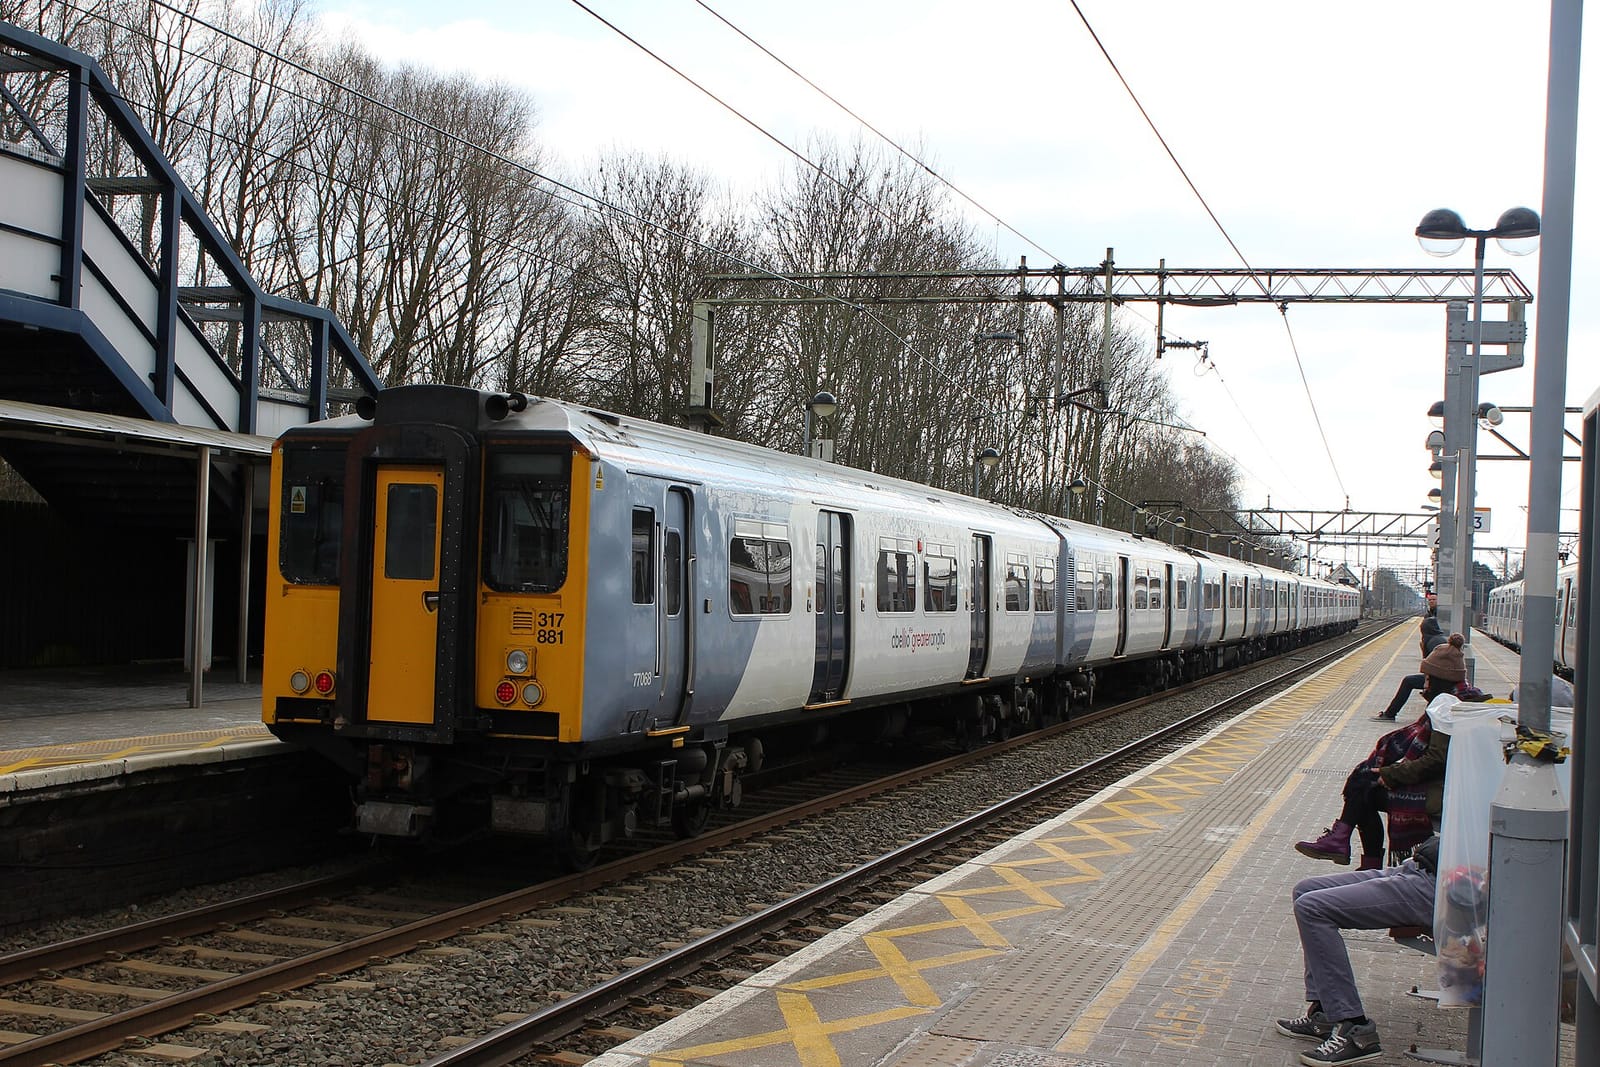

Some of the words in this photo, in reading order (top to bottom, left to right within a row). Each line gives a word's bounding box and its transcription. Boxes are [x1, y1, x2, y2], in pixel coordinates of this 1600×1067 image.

[817, 442, 823, 458] 1
[1473, 516, 1482, 529] 3
[538, 612, 565, 627] 317
[537, 629, 564, 645] 881
[892, 627, 910, 649] abellio
